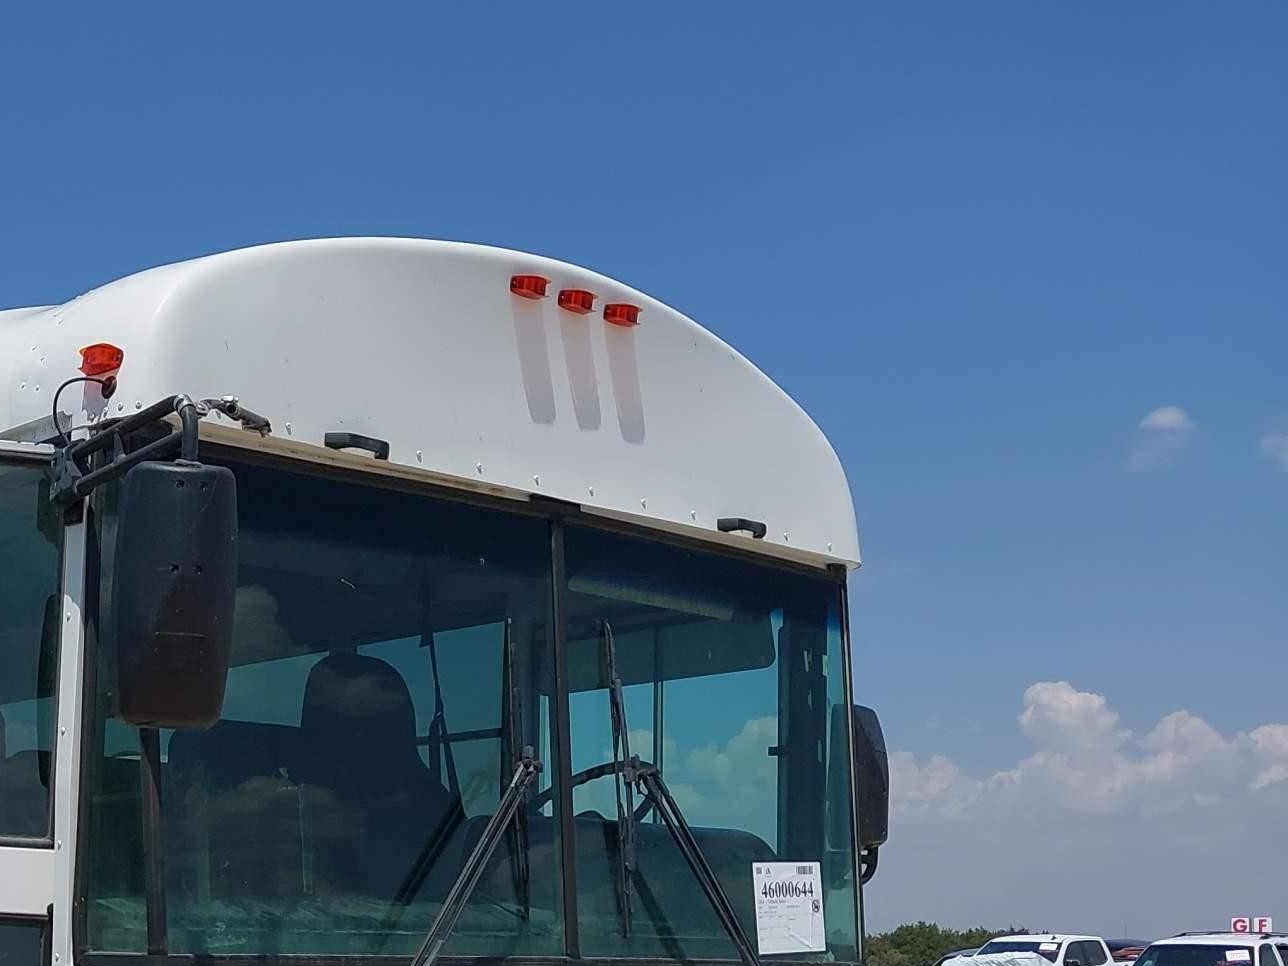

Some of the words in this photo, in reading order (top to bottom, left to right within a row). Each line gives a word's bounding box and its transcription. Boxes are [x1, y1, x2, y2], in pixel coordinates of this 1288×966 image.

[761, 881, 814, 898] 46000644
[1232, 918, 1248, 933] G
[1258, 919, 1267, 933] F
